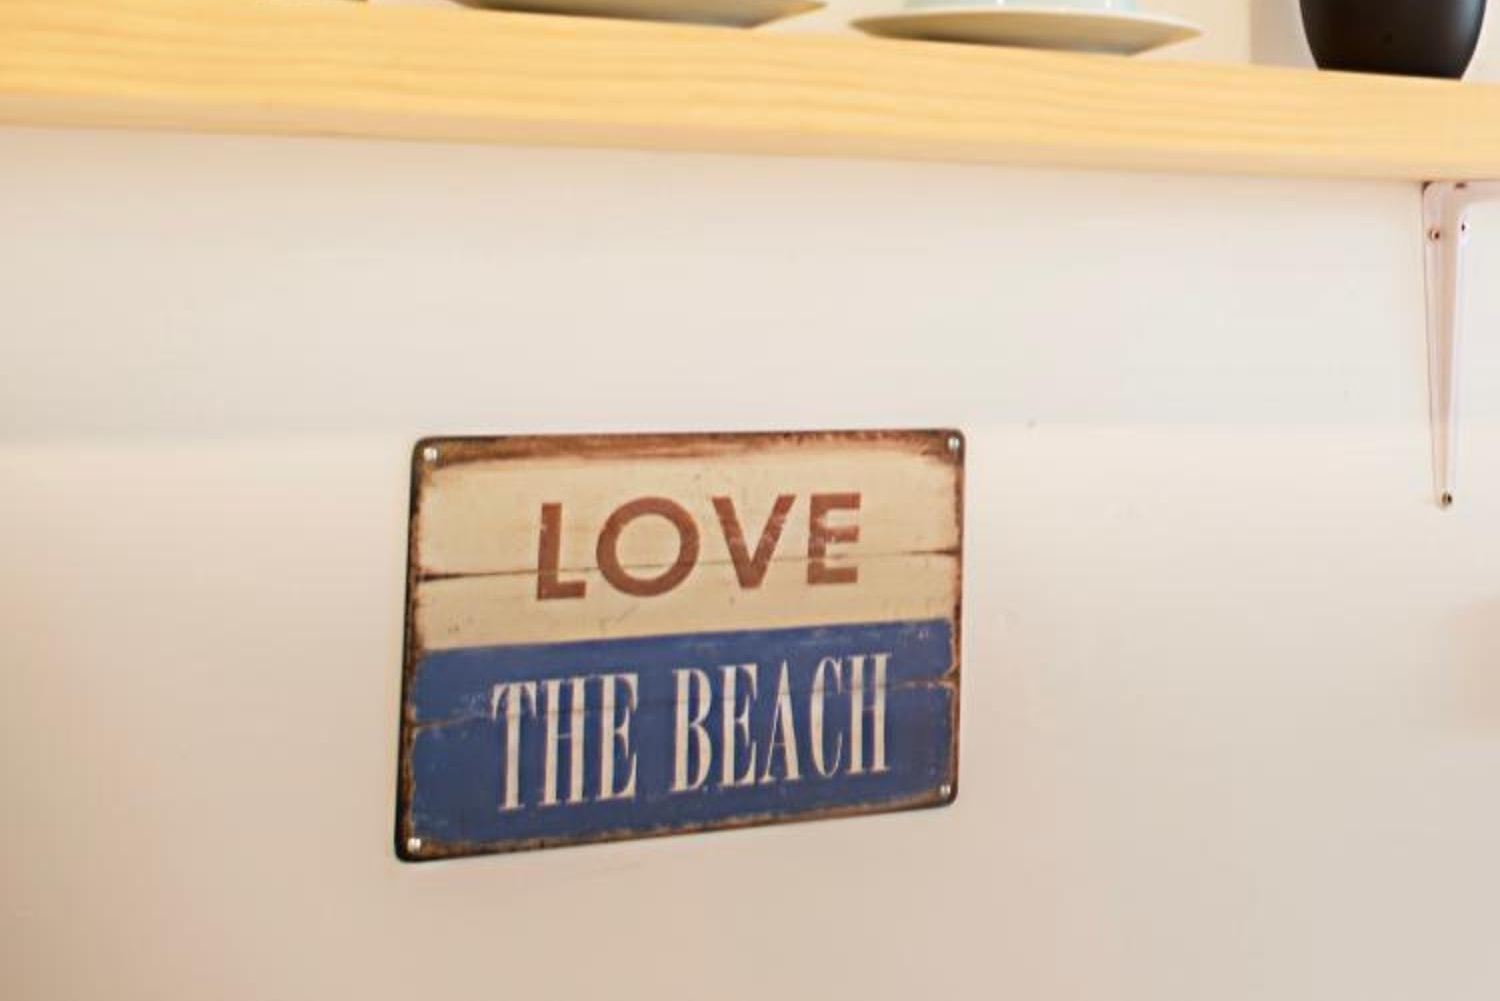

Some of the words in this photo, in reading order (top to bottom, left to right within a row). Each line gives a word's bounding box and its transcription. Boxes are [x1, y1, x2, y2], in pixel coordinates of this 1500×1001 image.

[536, 491, 861, 601] LOVE
[491, 672, 639, 812] THE
[670, 652, 893, 793] BEACH
